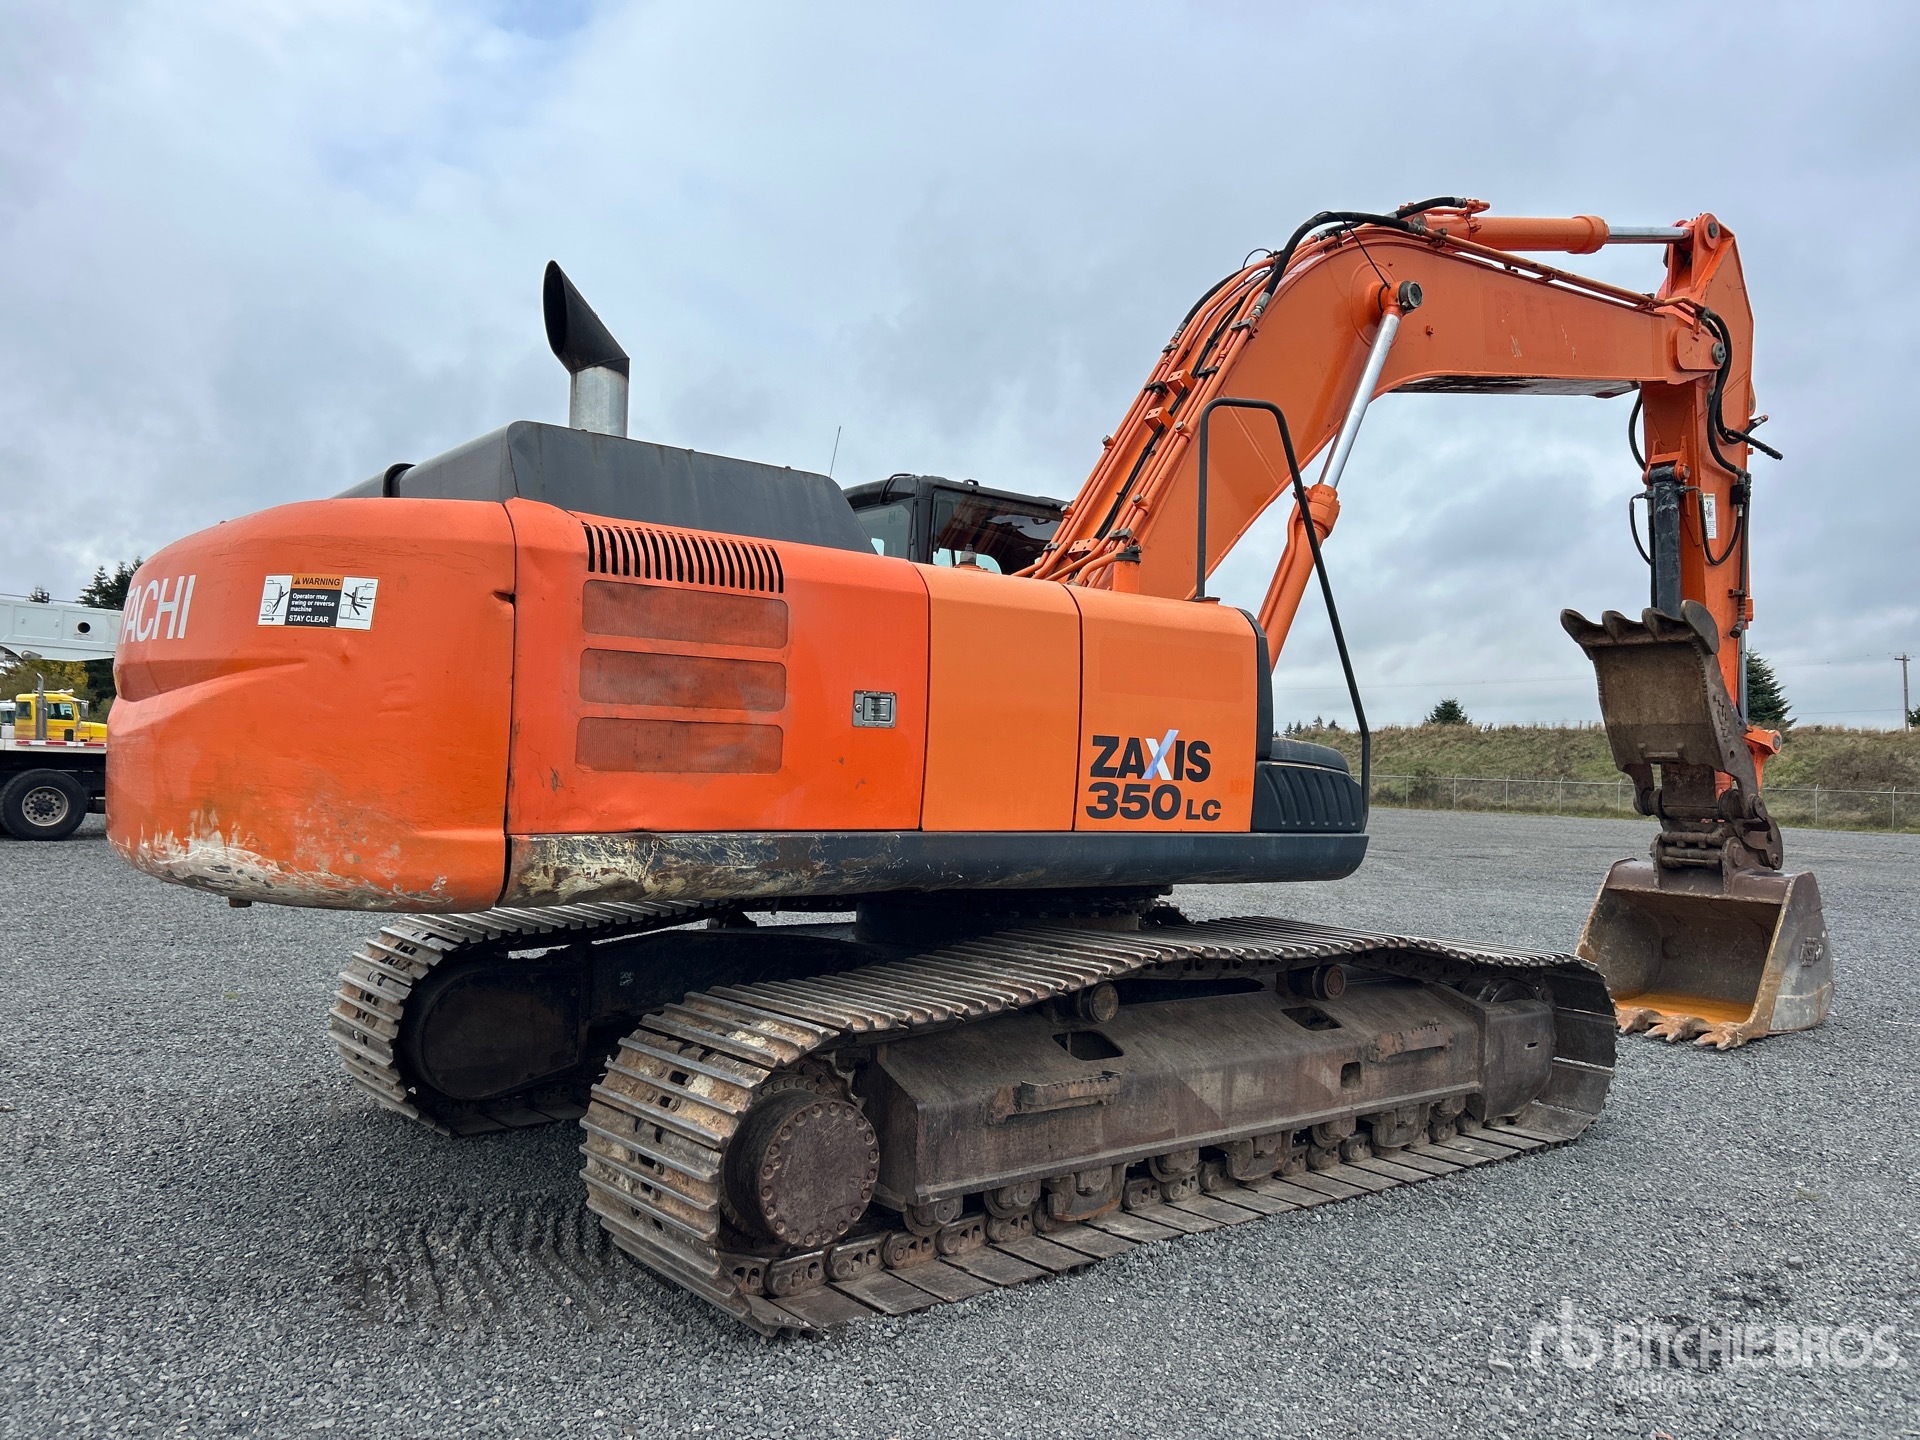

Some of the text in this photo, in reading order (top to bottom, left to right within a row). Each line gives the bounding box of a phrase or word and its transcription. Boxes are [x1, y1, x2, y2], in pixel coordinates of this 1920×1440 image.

[302, 577, 340, 586] WARNING
[292, 592, 315, 600] Operator
[291, 599, 306, 607] swing
[121, 574, 196, 646] TACHI
[288, 614, 329, 623] STAY CLEAR
[1090, 729, 1211, 782] ZAXIS
